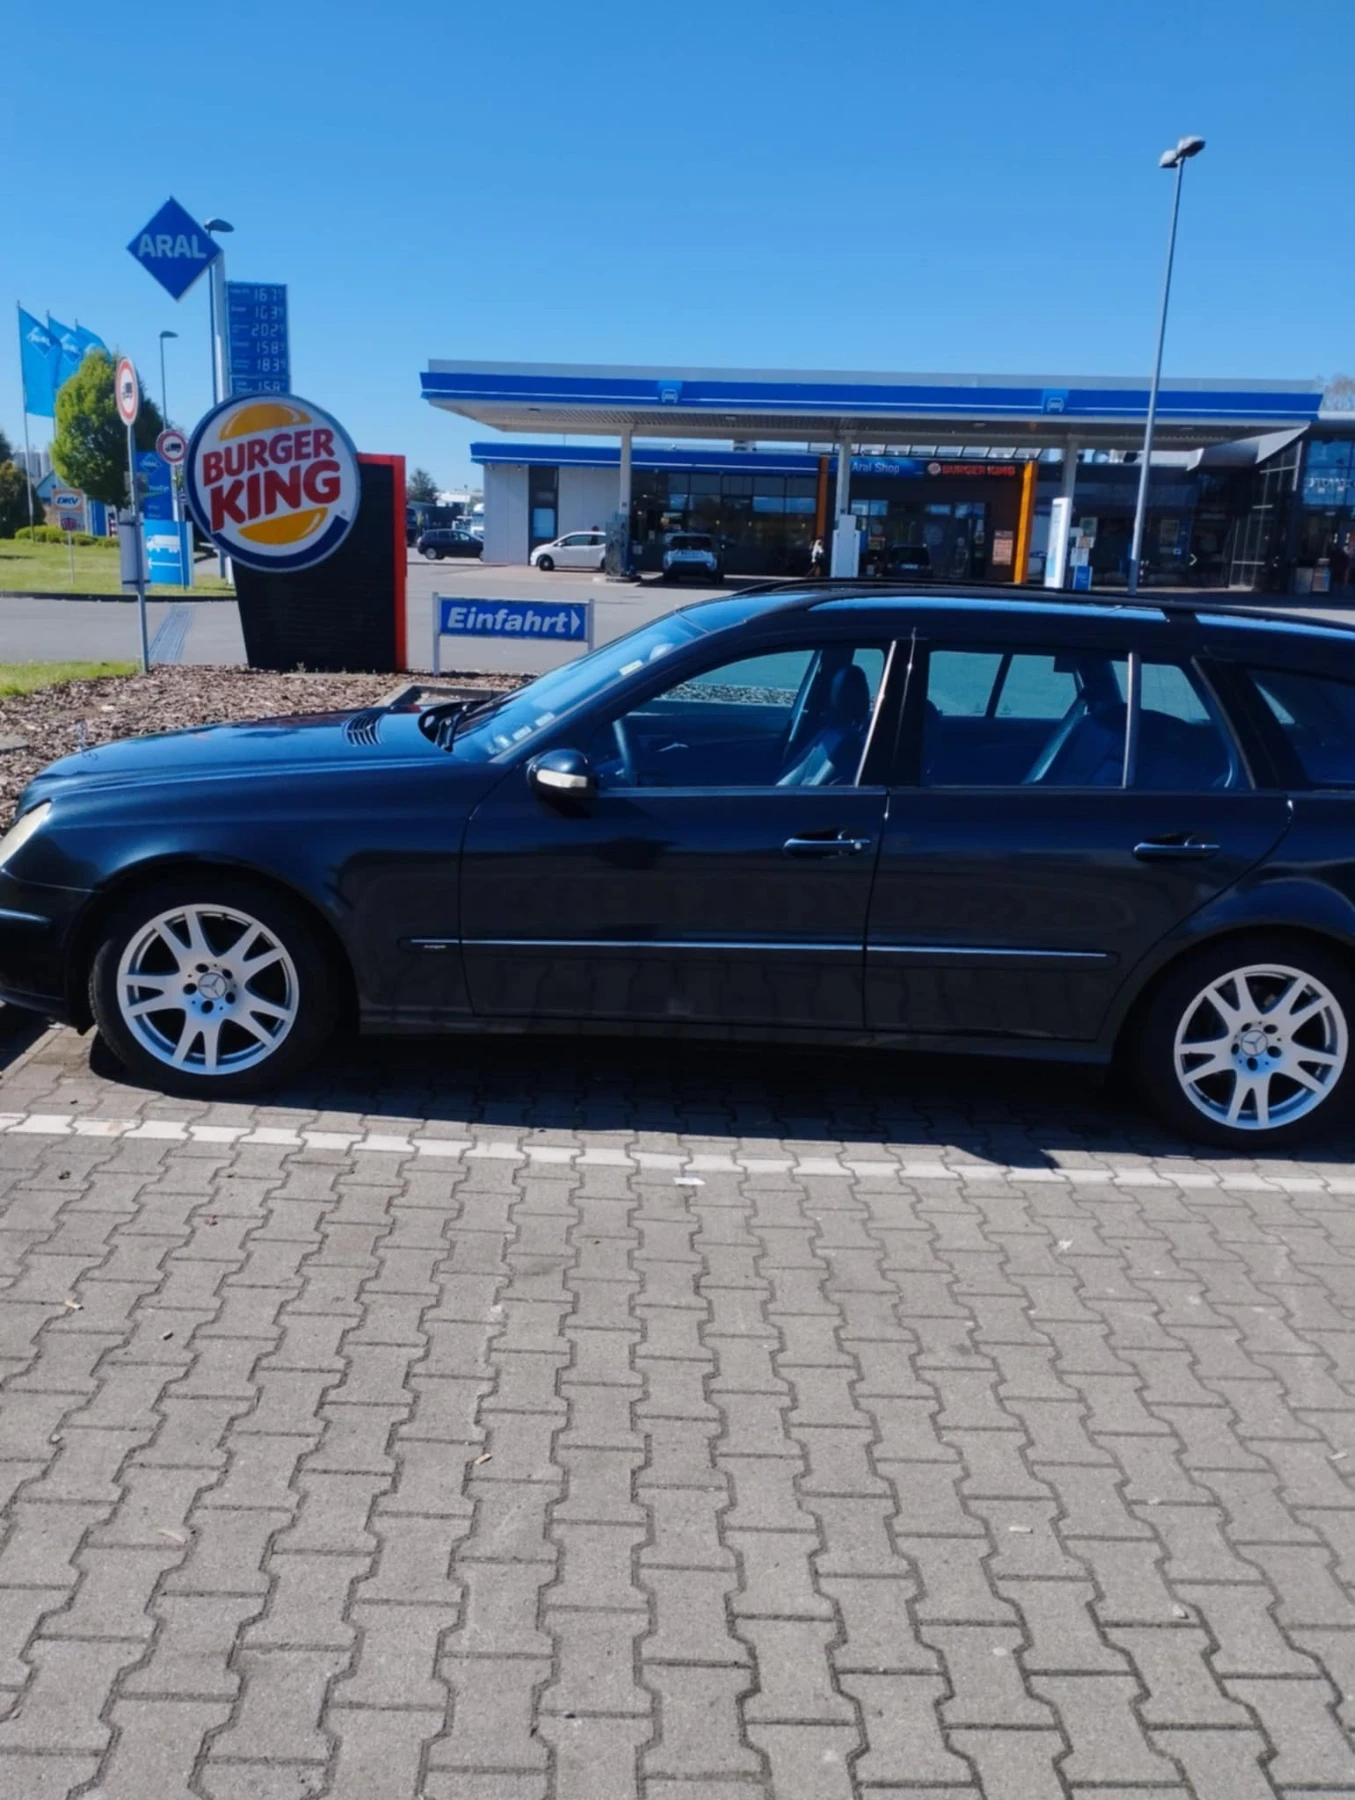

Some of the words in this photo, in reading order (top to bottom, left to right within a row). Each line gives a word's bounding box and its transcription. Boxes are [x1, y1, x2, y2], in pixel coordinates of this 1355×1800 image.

[138, 233, 206, 258] ARAL
[203, 428, 335, 487] BURGER
[851, 461, 872, 472] Aral
[874, 462, 900, 475] Shop
[210, 459, 341, 532] KING
[447, 607, 568, 633] Einfahrt
